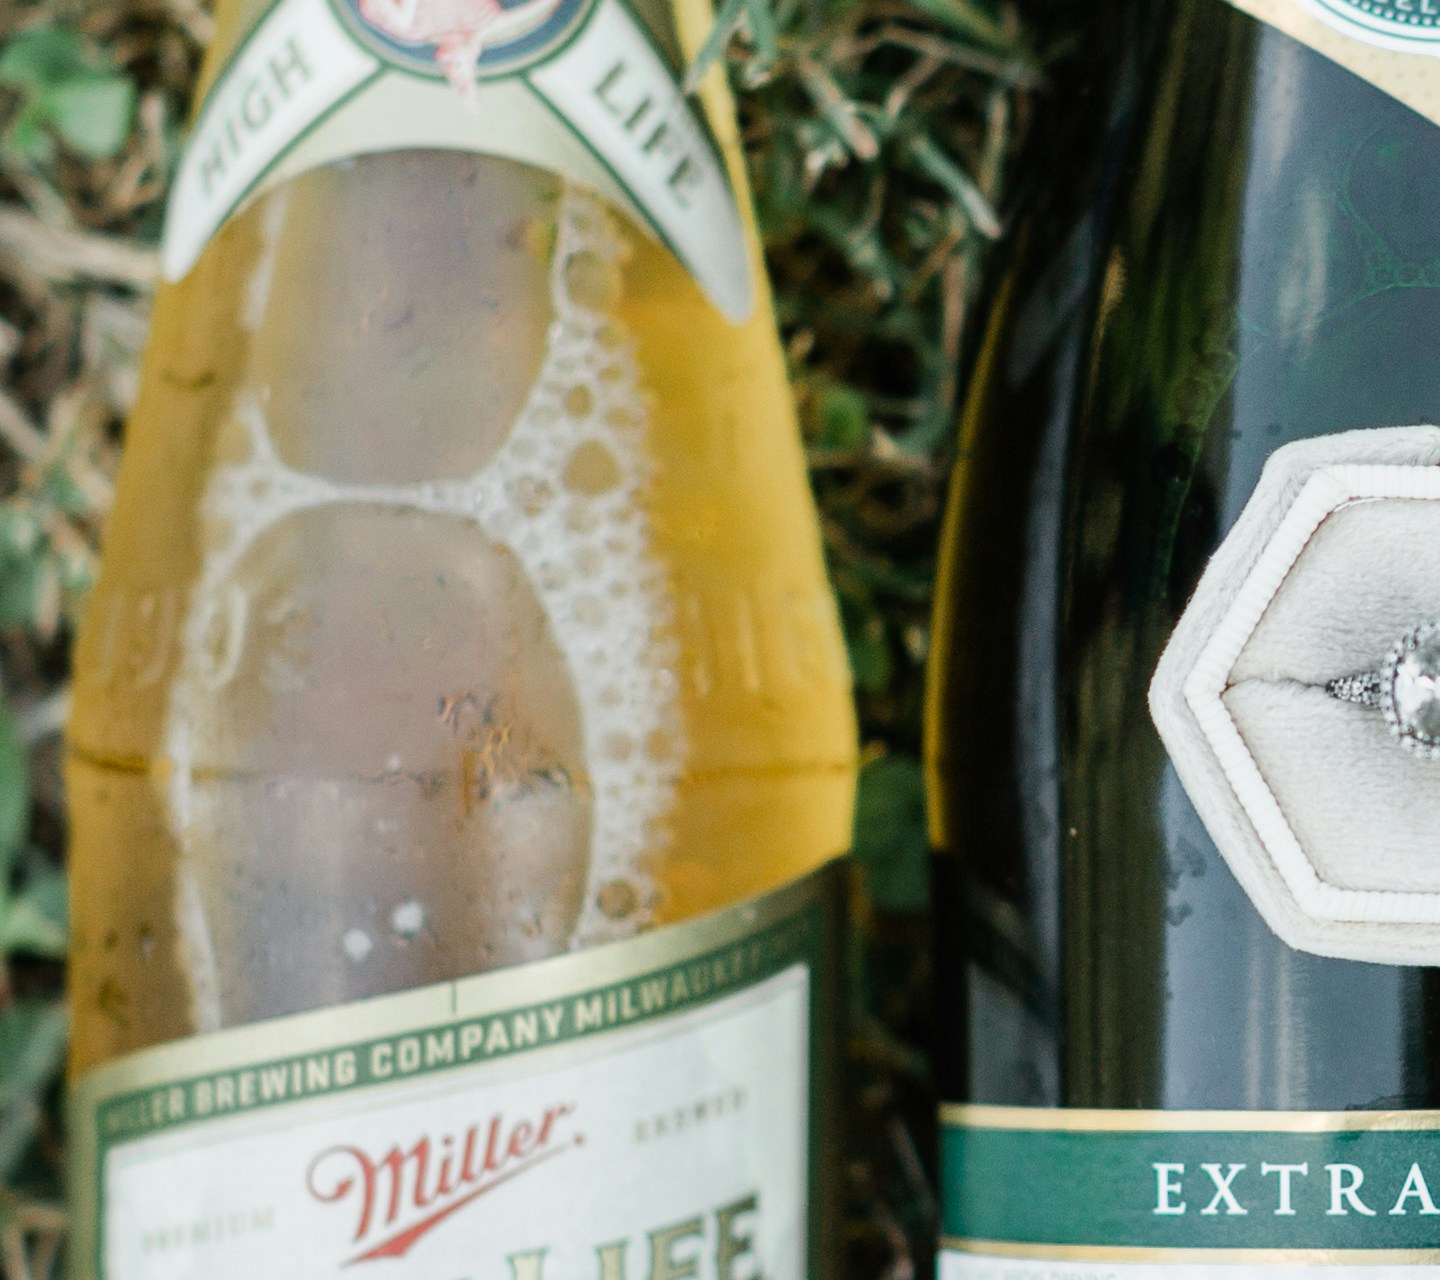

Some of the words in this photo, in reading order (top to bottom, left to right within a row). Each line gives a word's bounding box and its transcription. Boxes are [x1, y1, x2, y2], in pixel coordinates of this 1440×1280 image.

[195, 36, 316, 200] HIGH
[591, 57, 708, 211] LIFE
[195, 1050, 356, 1115] BREWING
[371, 1005, 562, 1077] COMPANY
[307, 1102, 580, 1246] Miller
